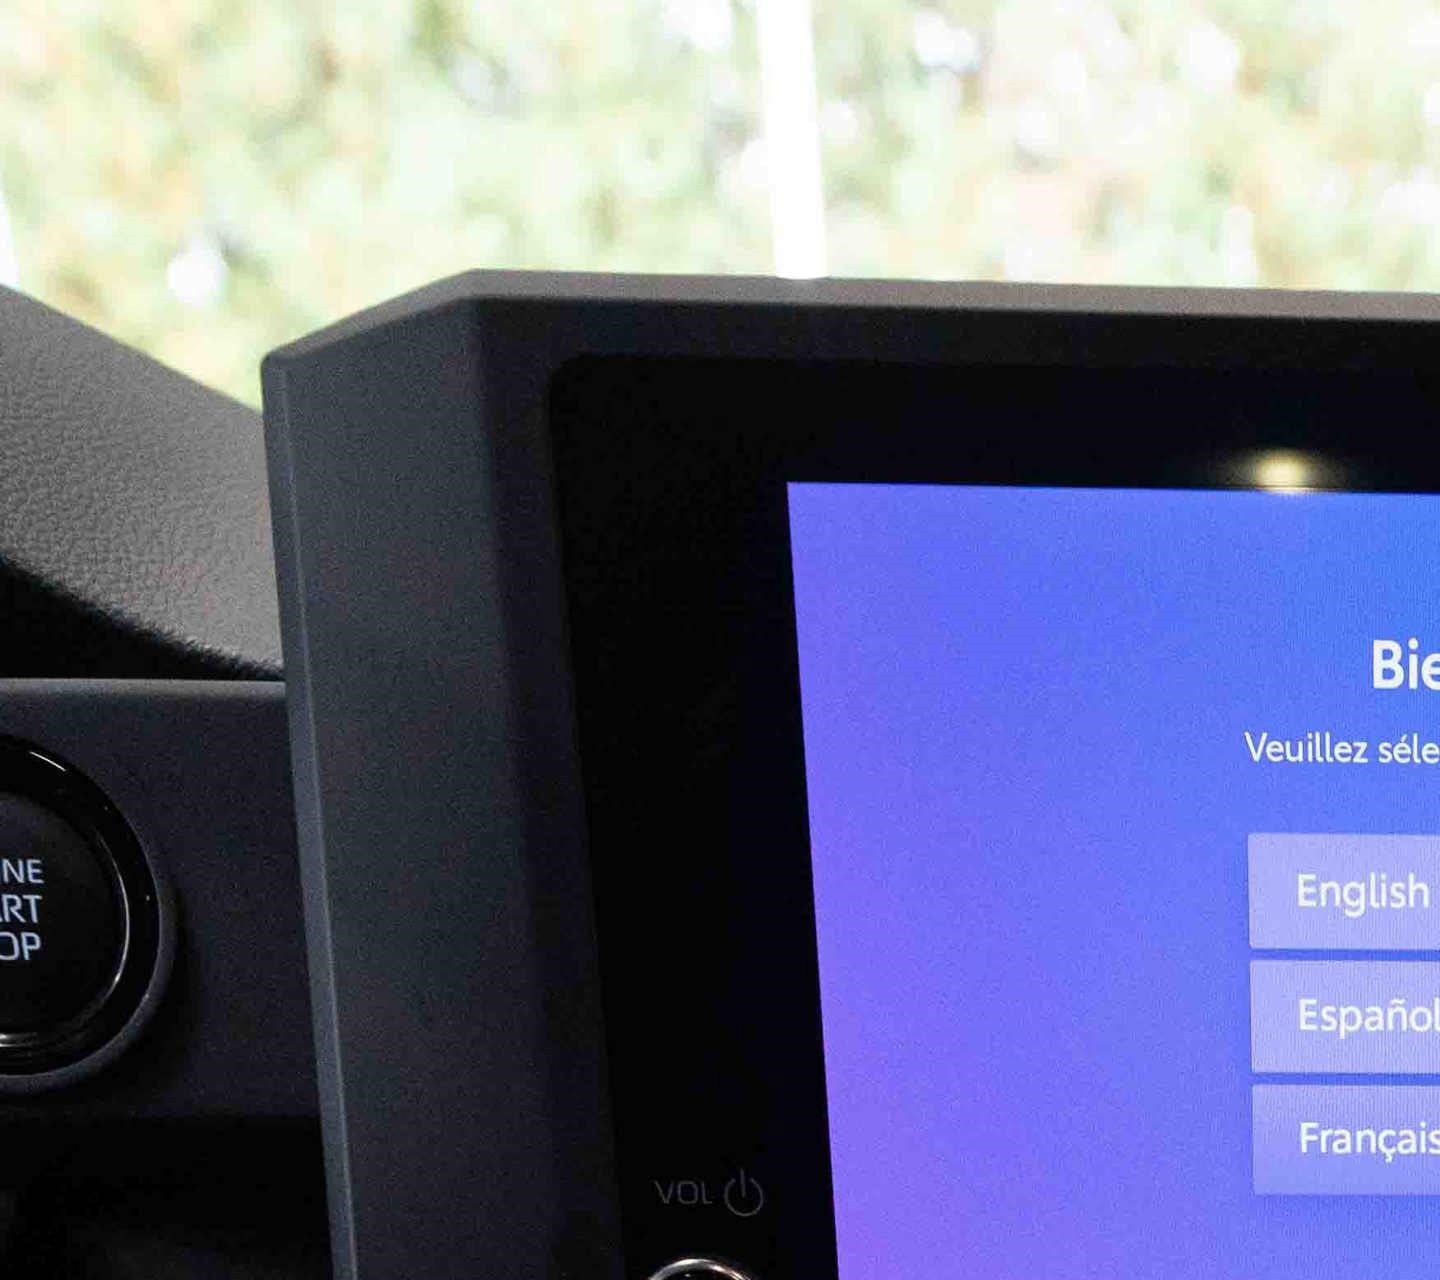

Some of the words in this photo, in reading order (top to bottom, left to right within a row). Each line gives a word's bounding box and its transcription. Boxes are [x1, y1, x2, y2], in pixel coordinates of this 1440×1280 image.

[1244, 732, 1368, 765] Veuillez
[1296, 873, 1431, 917] English
[653, 1179, 713, 1206] VOL
